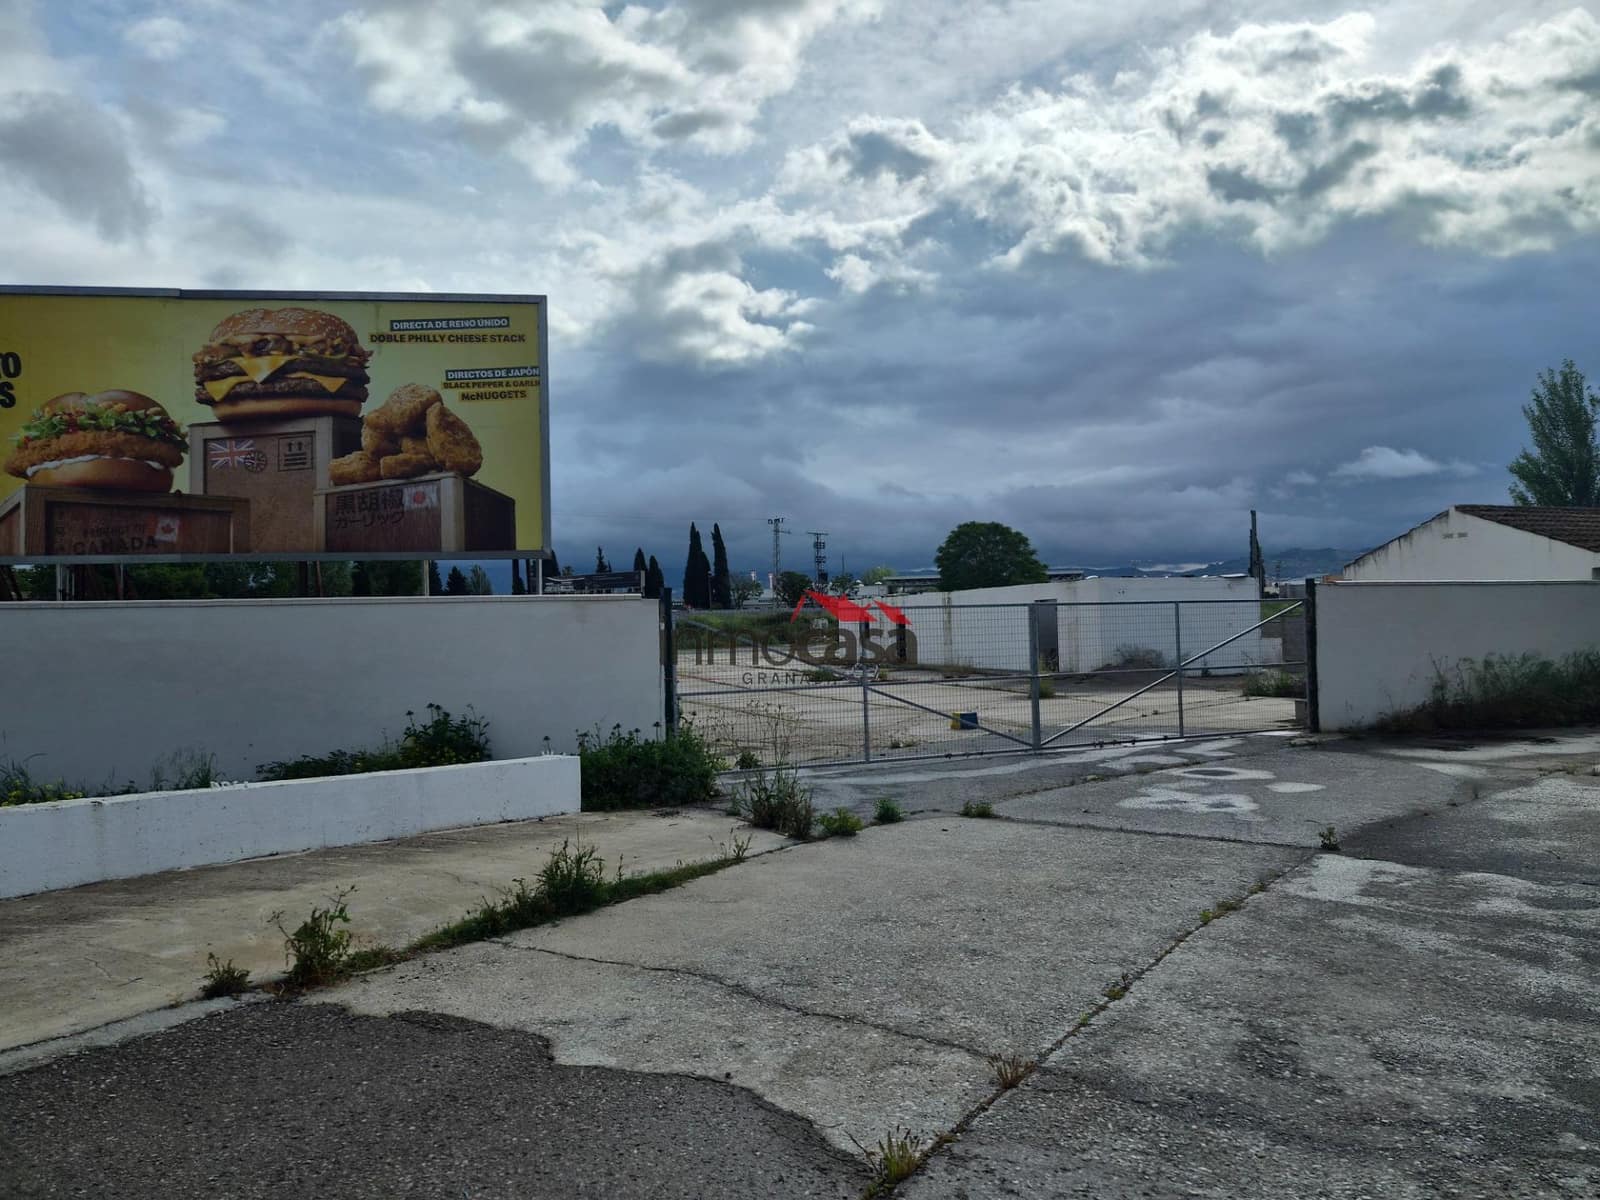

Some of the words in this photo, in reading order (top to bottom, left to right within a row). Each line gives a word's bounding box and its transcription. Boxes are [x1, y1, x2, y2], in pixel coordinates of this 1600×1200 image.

[392, 320, 434, 330] DIRECTA
[435, 319, 449, 329] DE
[449, 319, 476, 329] REINO
[478, 317, 508, 327] UNIDO
[370, 334, 407, 343] DOBLE
[407, 334, 447, 343] PHILLY
[448, 334, 489, 343] CHEESE
[490, 334, 526, 343] STACK
[0, 351, 22, 378] O
[447, 370, 494, 380] DIRECTOS
[494, 369, 508, 378] DE
[508, 366, 540, 377] JAPÓN
[443, 382, 472, 390] BLACK
[472, 381, 504, 389] PEPPER
[461, 390, 527, 402] McNUGGETS
[335, 511, 405, 529] ガーリック
